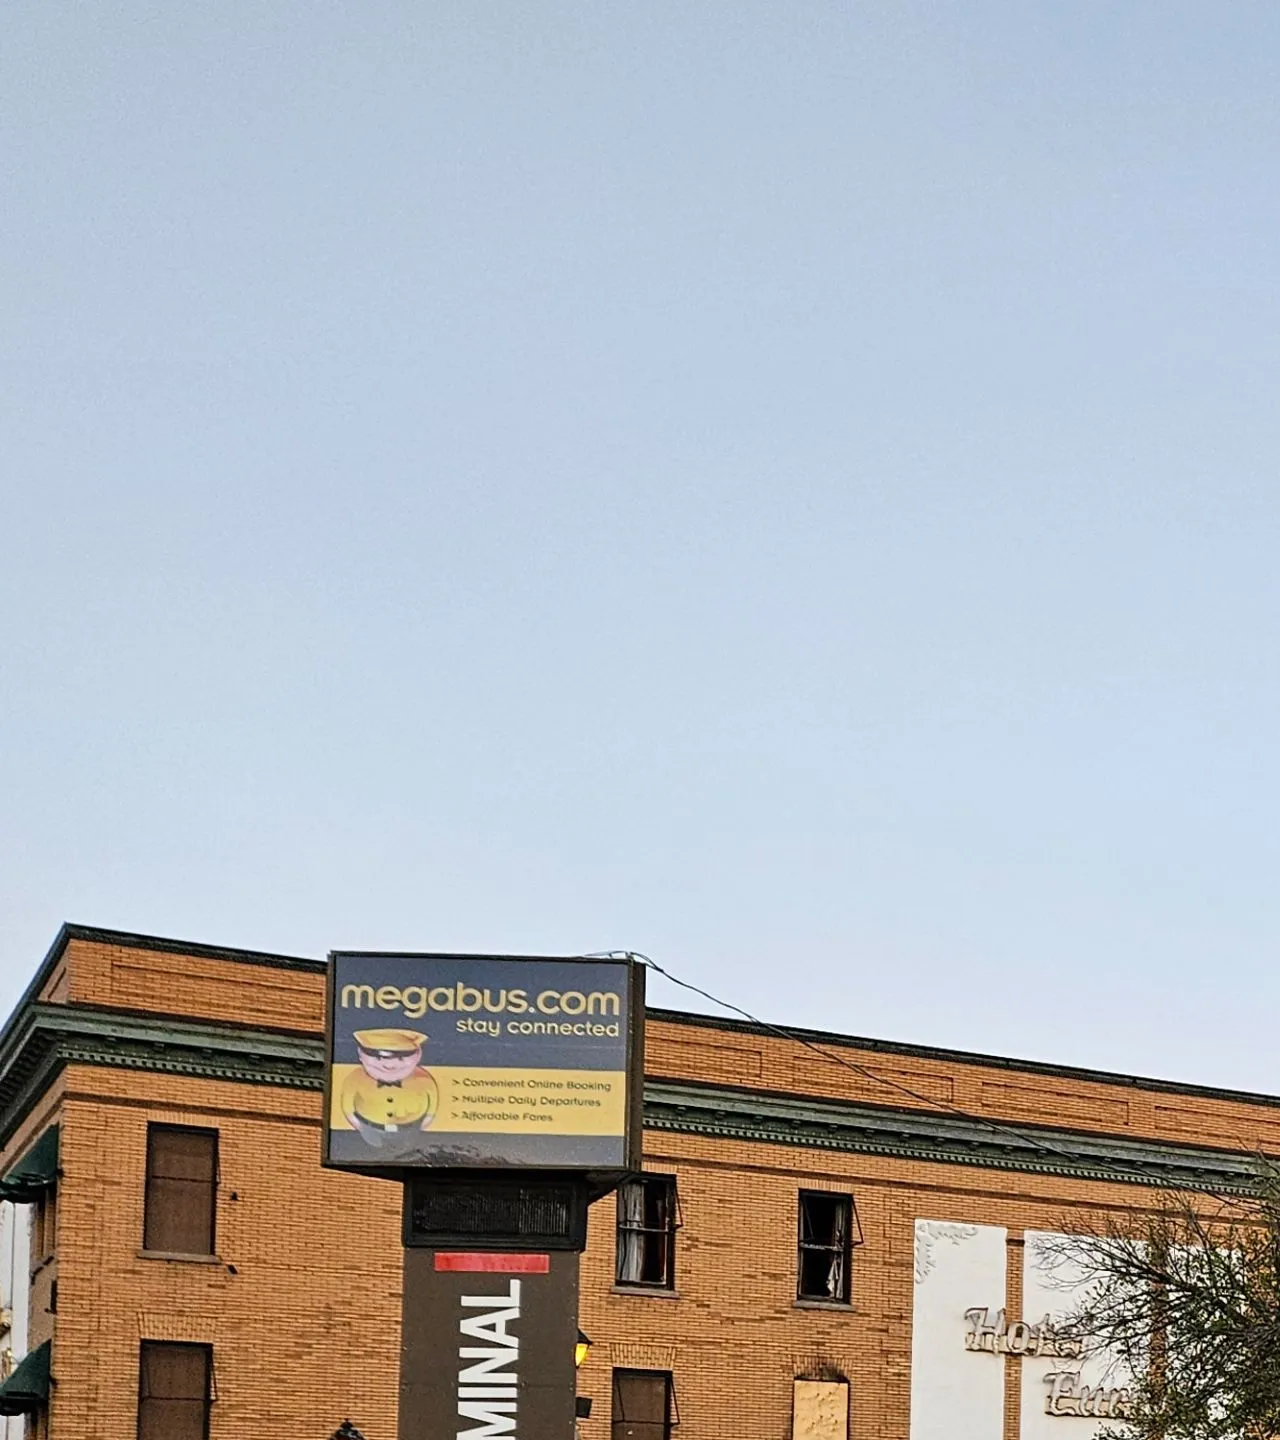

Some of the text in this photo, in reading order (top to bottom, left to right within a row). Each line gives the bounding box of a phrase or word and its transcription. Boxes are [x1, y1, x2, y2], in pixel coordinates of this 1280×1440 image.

[341, 981, 620, 1019] megabus.com
[456, 1017, 619, 1038] stay connected
[463, 1078, 612, 1092] Convenient Online Booking
[508, 1096, 537, 1107] Daily
[540, 1096, 601, 1107] Departures
[523, 1112, 553, 1122] Fares
